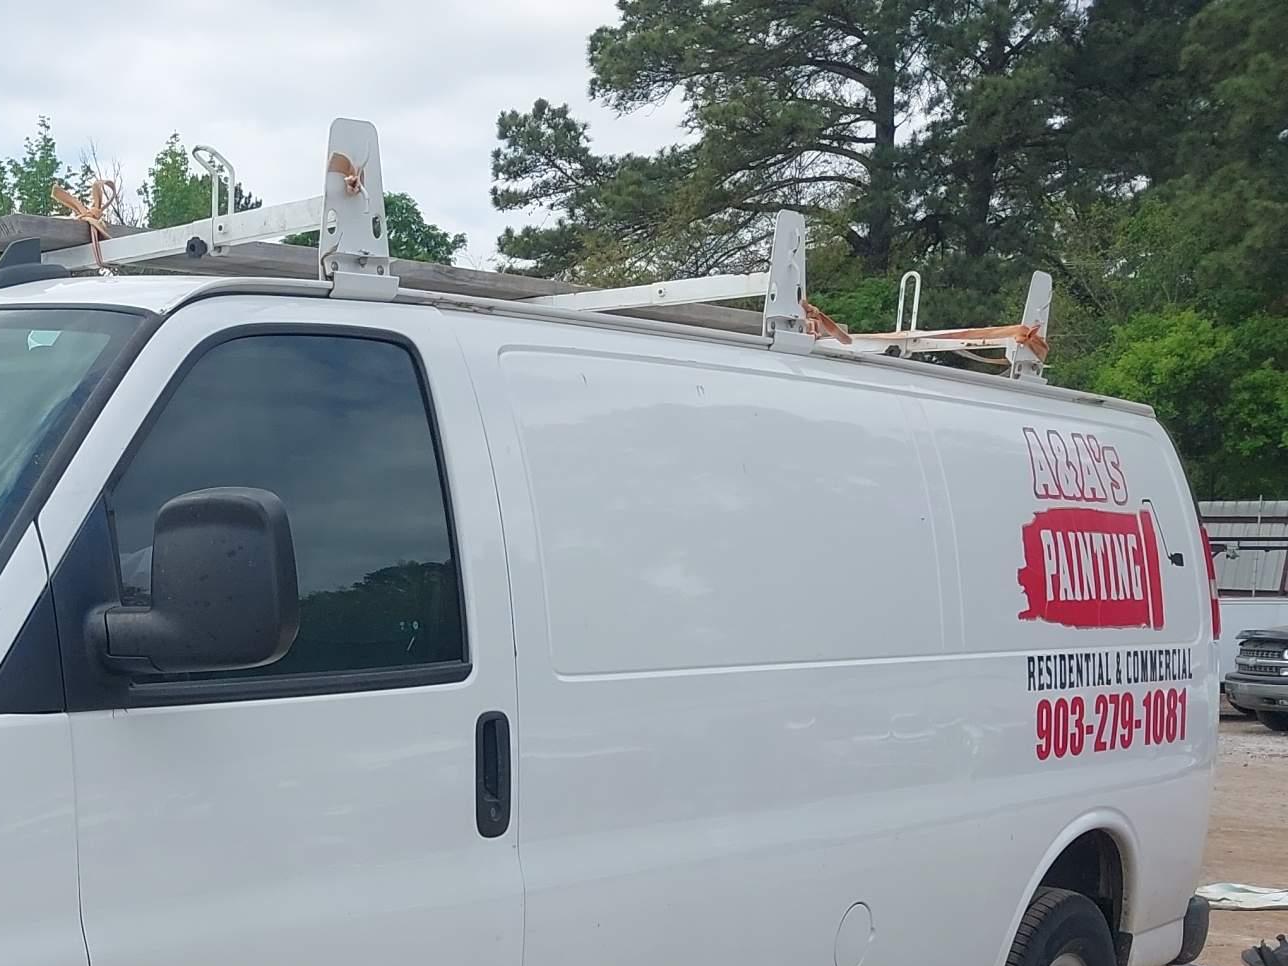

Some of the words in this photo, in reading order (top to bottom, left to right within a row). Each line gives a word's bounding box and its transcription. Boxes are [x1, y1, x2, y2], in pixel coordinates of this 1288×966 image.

[1040, 529, 1144, 602] PAINTING
[1027, 652, 1112, 691] RESIDENTIAL
[1116, 651, 1123, 685] &
[1126, 648, 1193, 684] COMMERCIAL
[1035, 687, 1188, 761] 903-279-1081
